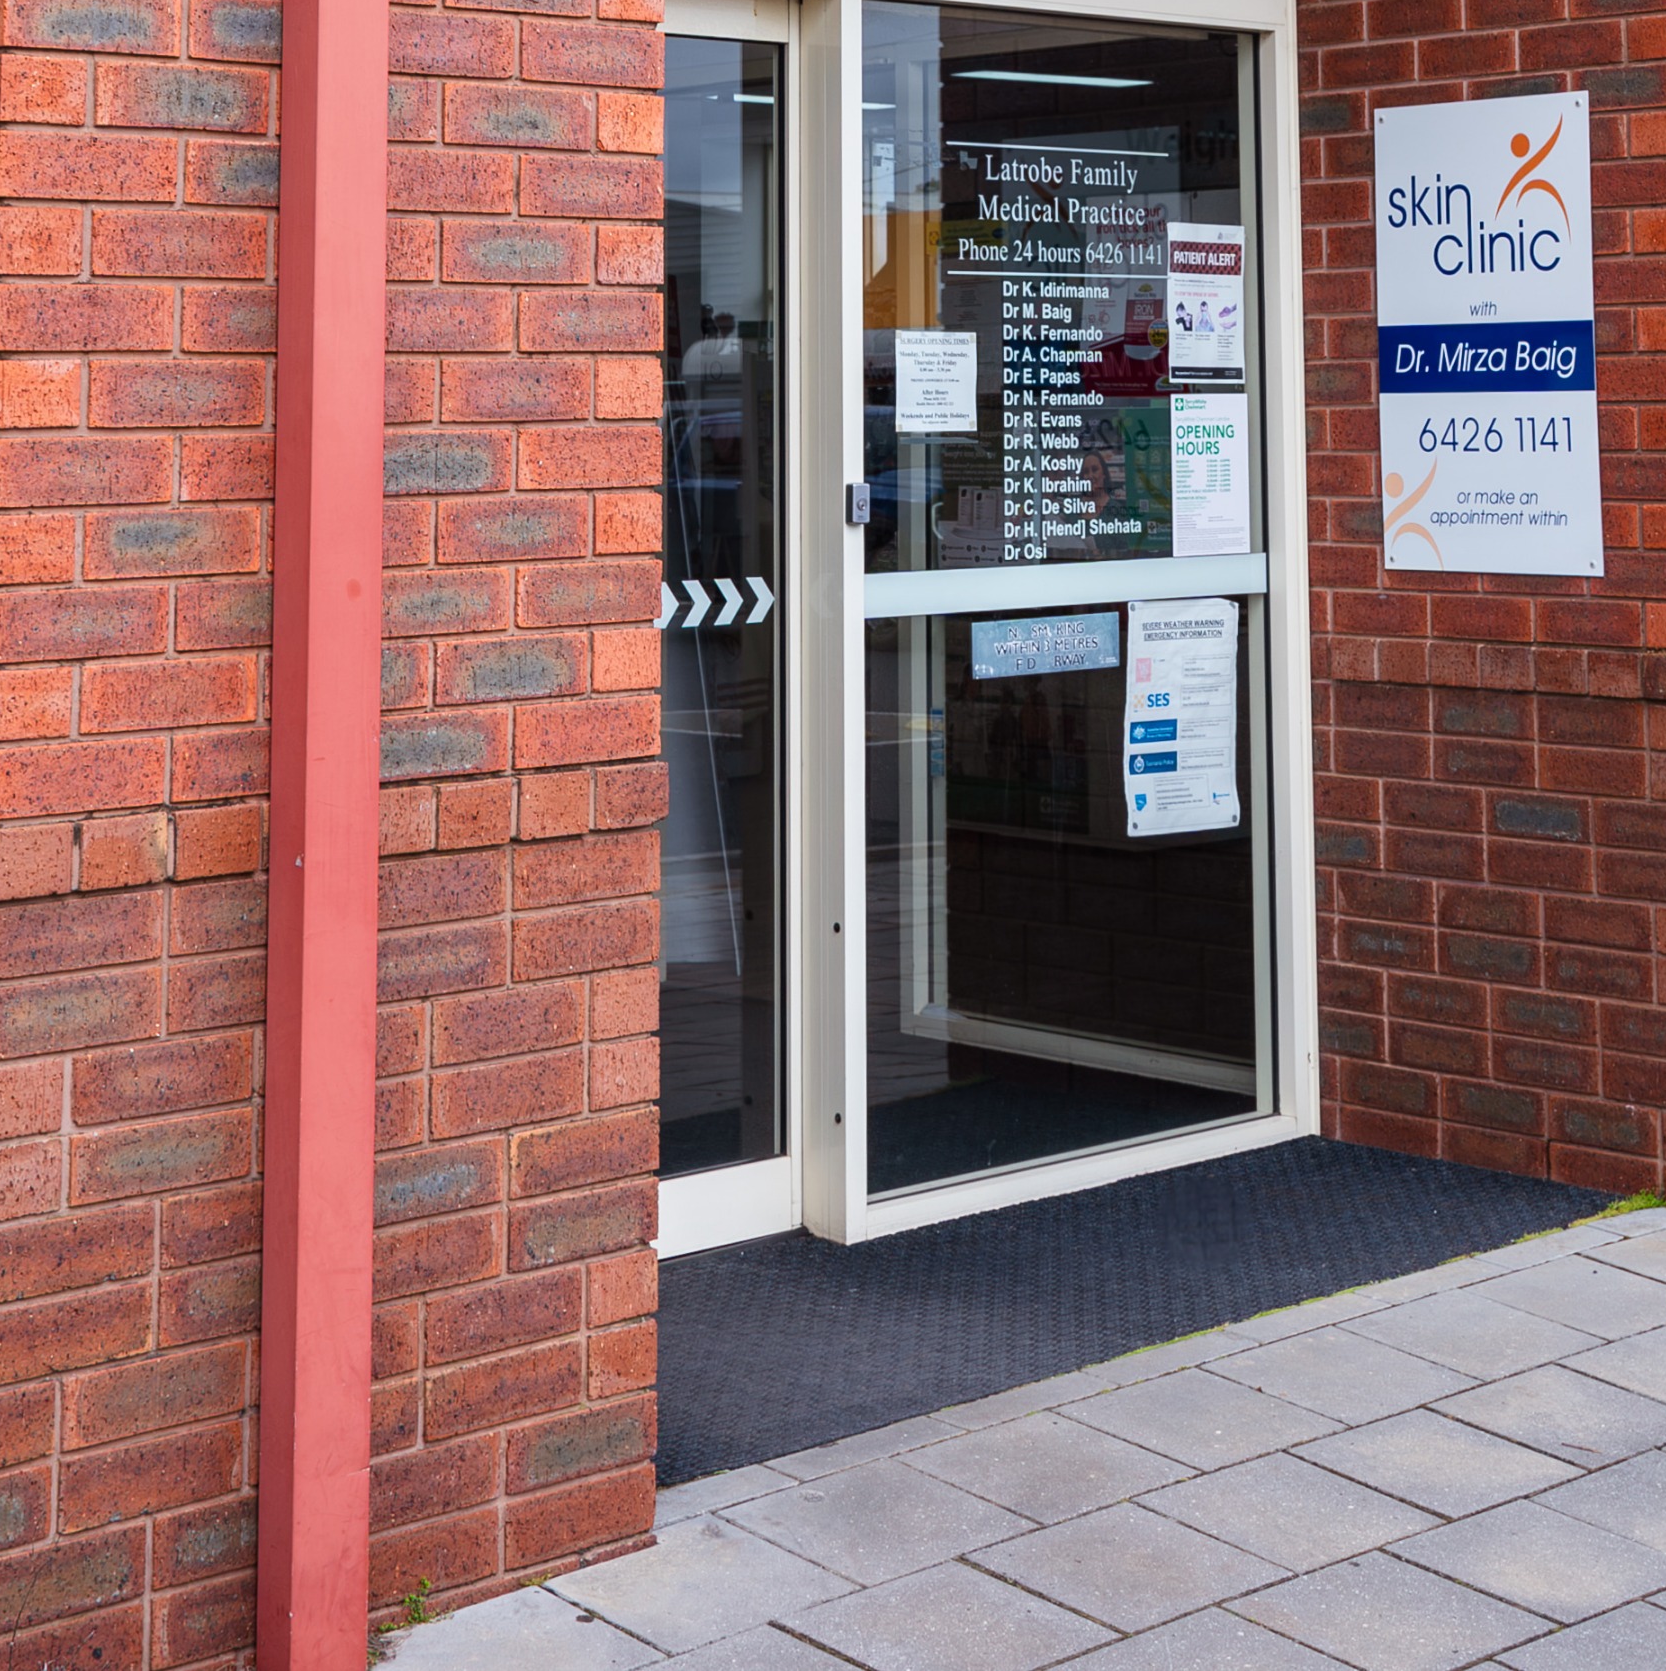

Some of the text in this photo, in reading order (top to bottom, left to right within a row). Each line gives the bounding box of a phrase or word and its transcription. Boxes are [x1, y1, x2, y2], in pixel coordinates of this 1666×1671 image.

[985, 154, 1138, 194] Latrobe Family
[1388, 174, 1472, 228] skin
[978, 194, 1060, 223] Medical
[1067, 198, 1146, 226] Practice
[958, 238, 1163, 265] Phone 24 hours 6426 1141
[1433, 219, 1561, 275] clinic
[1173, 251, 1236, 266] PATIENT ALERT
[1003, 281, 1109, 299] Dr K. Idirimanna
[1003, 303, 1072, 323] Dr M. Baig
[1469, 301, 1498, 316] with
[1003, 325, 1103, 341] Dr K. Fernando
[1003, 346, 1103, 366] Dr A. Chapman
[1395, 340, 1577, 379] Dr. Mirza Baig
[1003, 368, 1081, 387] Dr E. Papas
[1003, 390, 1104, 406] Dr N. Fernando
[1003, 412, 1082, 427] Dr R. Evans
[1176, 424, 1235, 440] OPENING
[1419, 417, 1572, 453] 6426 1141
[1003, 433, 1079, 450] Dr R. Webb
[1176, 441, 1220, 456] HOURS
[1003, 455, 1083, 474] Dr A. Koshy
[1003, 477, 1092, 493] Dr K. Ibrahim
[1457, 490, 1539, 505] or make an
[1003, 498, 1096, 516] Dr C. De Silva
[1430, 510, 1568, 527] appointment within
[1003, 518, 1142, 540] Dr H. [Hend] Shehata
[1004, 545, 1021, 560] Dr
[1024, 543, 1047, 559] Osi
[1031, 622, 1085, 637] SMKING
[1163, 620, 1193, 629] WEATHER
[1194, 619, 1224, 628] WARNING
[1144, 630, 1222, 640] EMERGENCY INFORMATION
[994, 641, 1040, 655] WITHIN
[1054, 636, 1099, 651] METRES
[1147, 692, 1170, 708] SES
